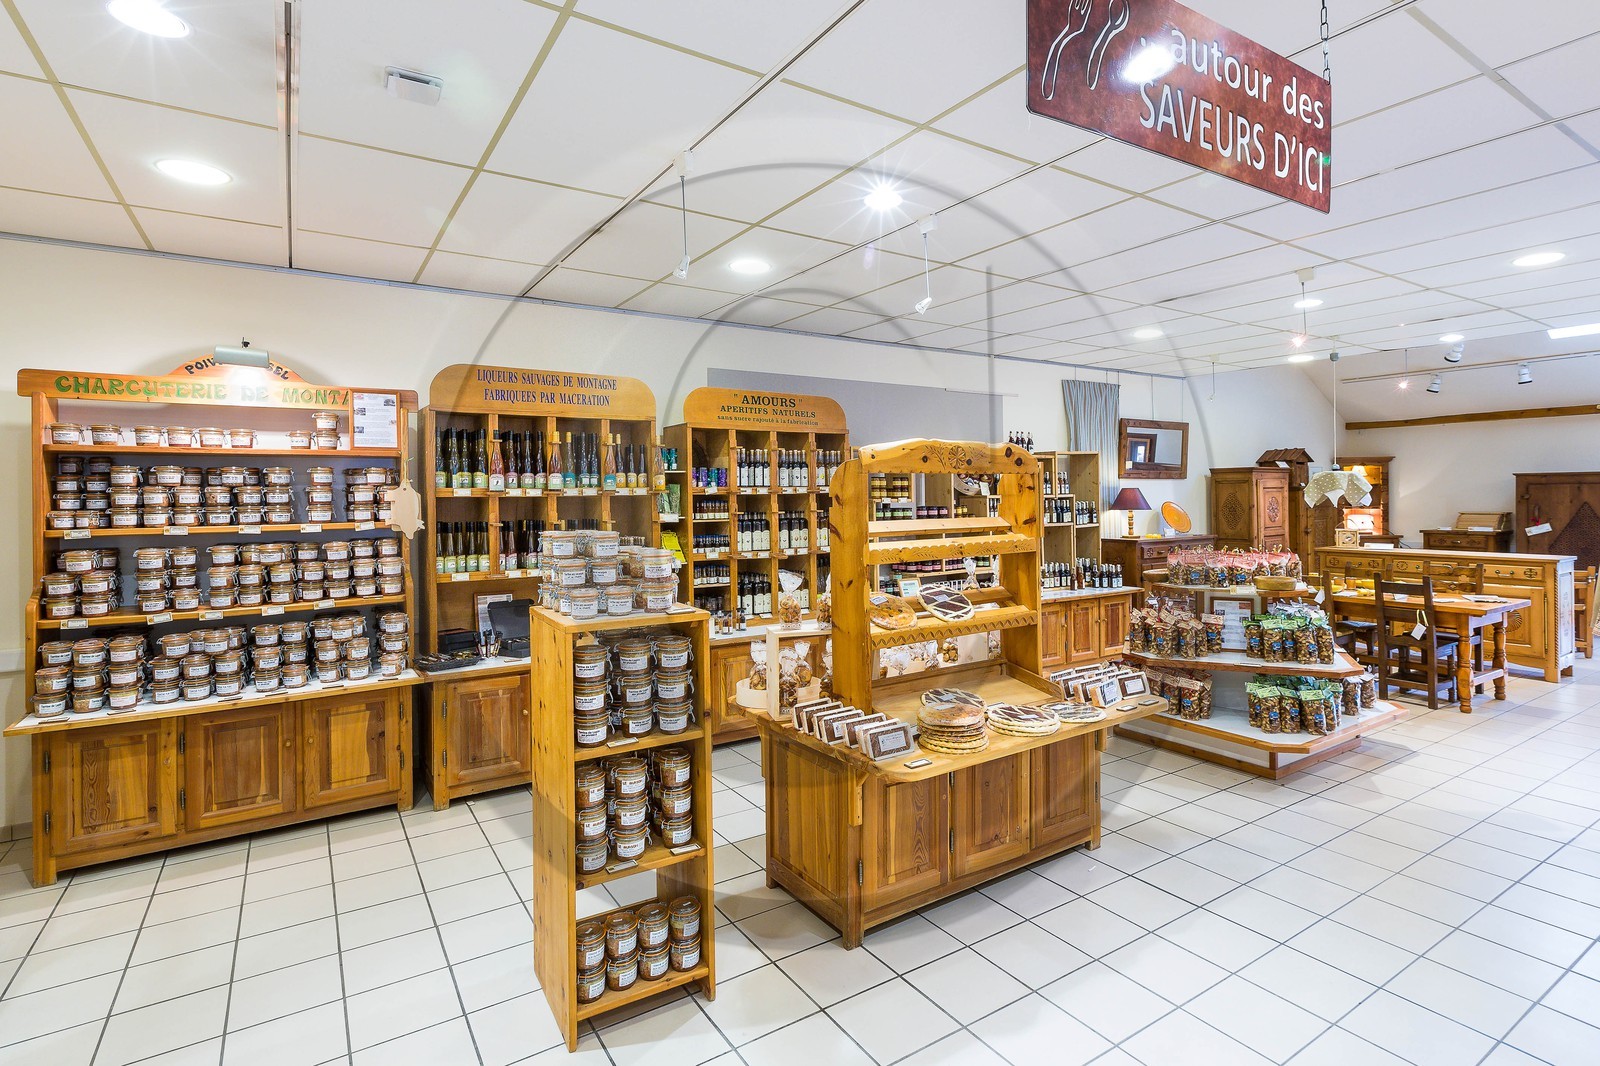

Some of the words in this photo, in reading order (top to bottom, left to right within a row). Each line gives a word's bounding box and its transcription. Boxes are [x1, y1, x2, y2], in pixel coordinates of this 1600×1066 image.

[1282, 76, 1324, 130] des
[1139, 79, 1266, 171] SAVEURS
[1273, 131, 1324, 193] D'ICI
[185, 356, 222, 375] POIV
[54, 375, 228, 401] CHARCUTERIE
[240, 385, 270, 402] DE
[476, 368, 518, 385] LIQUEURS
[521, 372, 560, 387] SAUVAGES
[563, 376, 574, 388] DE
[576, 377, 617, 391] MONTAGNE
[484, 388, 537, 404] FABRIQUEES
[540, 391, 556, 404] PAR
[559, 393, 610, 407] MACERATION
[741, 394, 796, 408] AMOURS
[720, 405, 769, 415] APERITIFS
[772, 408, 816, 419] NATURELS
